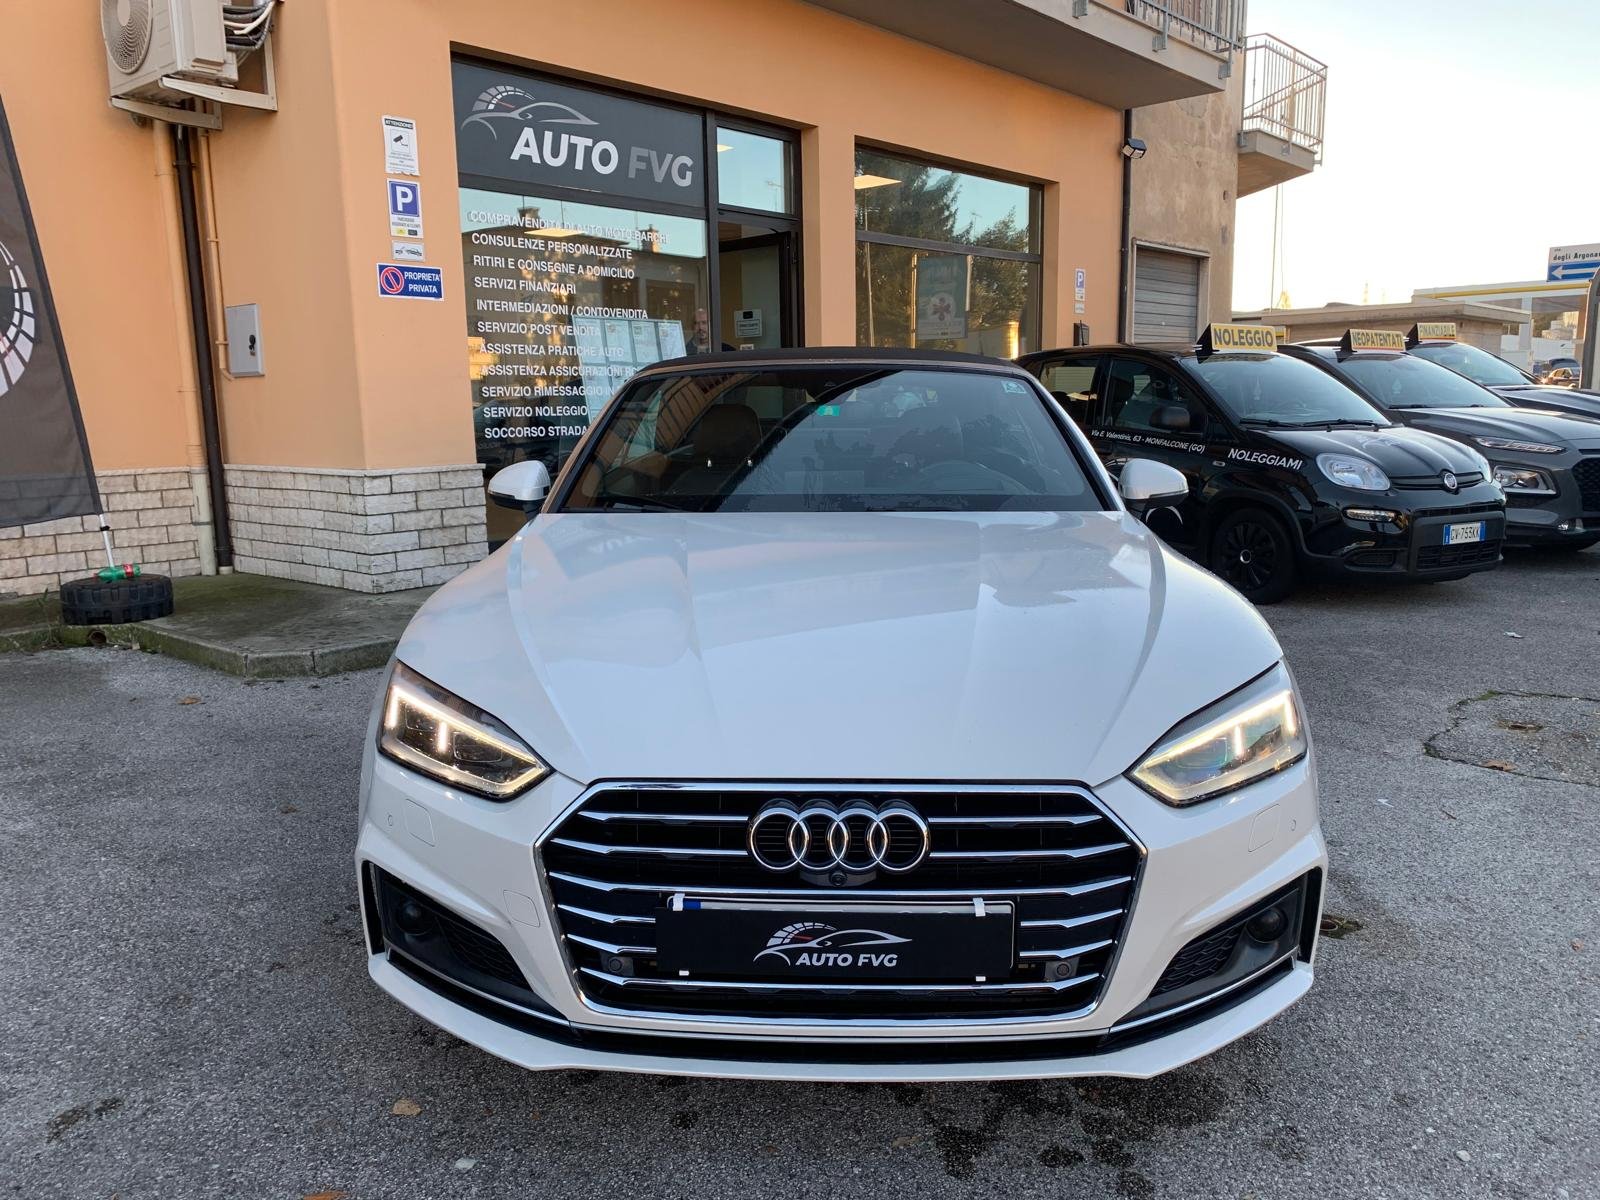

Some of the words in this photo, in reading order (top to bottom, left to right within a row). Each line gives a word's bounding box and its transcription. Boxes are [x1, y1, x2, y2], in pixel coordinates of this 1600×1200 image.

[510, 126, 619, 175] AUTO
[628, 146, 694, 187] FVG
[395, 185, 413, 212] P
[471, 232, 545, 251] CONSULENZE
[547, 240, 633, 259] PERSONALIZZATE
[1553, 253, 1571, 261] degli
[473, 254, 505, 268] RITIRI
[507, 258, 515, 269] E
[517, 259, 576, 274] CONSEGNE
[577, 264, 584, 275] A
[586, 265, 635, 279] DOMICILIO
[408, 283, 438, 294] PRIVATA
[474, 276, 517, 290] SERVIZI
[519, 280, 576, 294] FINANZIARI
[476, 298, 569, 316] INTERMEDIAZIONI
[576, 305, 648, 320] CONTOVENDITA
[477, 321, 528, 334] SERVIZIO
[530, 323, 558, 335] POST
[559, 325, 600, 336] VENDITA
[1214, 328, 1274, 347] NOLEGGIO
[1352, 331, 1403, 349] NEOPATENTATI
[480, 342, 546, 355] ASSISTENZA
[548, 344, 597, 358] PRATICHE
[599, 346, 625, 357] AUTO
[481, 364, 547, 376] ASSISTENZA
[549, 365, 624, 377] ASSICURAZIONI
[481, 386, 531, 397] SERVIZIO
[534, 385, 603, 397] RIMESSAGGIO
[483, 406, 532, 417] SERVIZIO
[535, 405, 588, 417] NOLEGGIO
[484, 427, 546, 438] SOCCORSO
[1091, 429, 1100, 437] Via
[1145, 437, 1189, 450] MONFALCONE
[1188, 443, 1206, 454] (GO)
[1227, 448, 1303, 471] NOLEGGIAMI
[795, 952, 853, 967] AUTO
[857, 954, 898, 967] FVG
